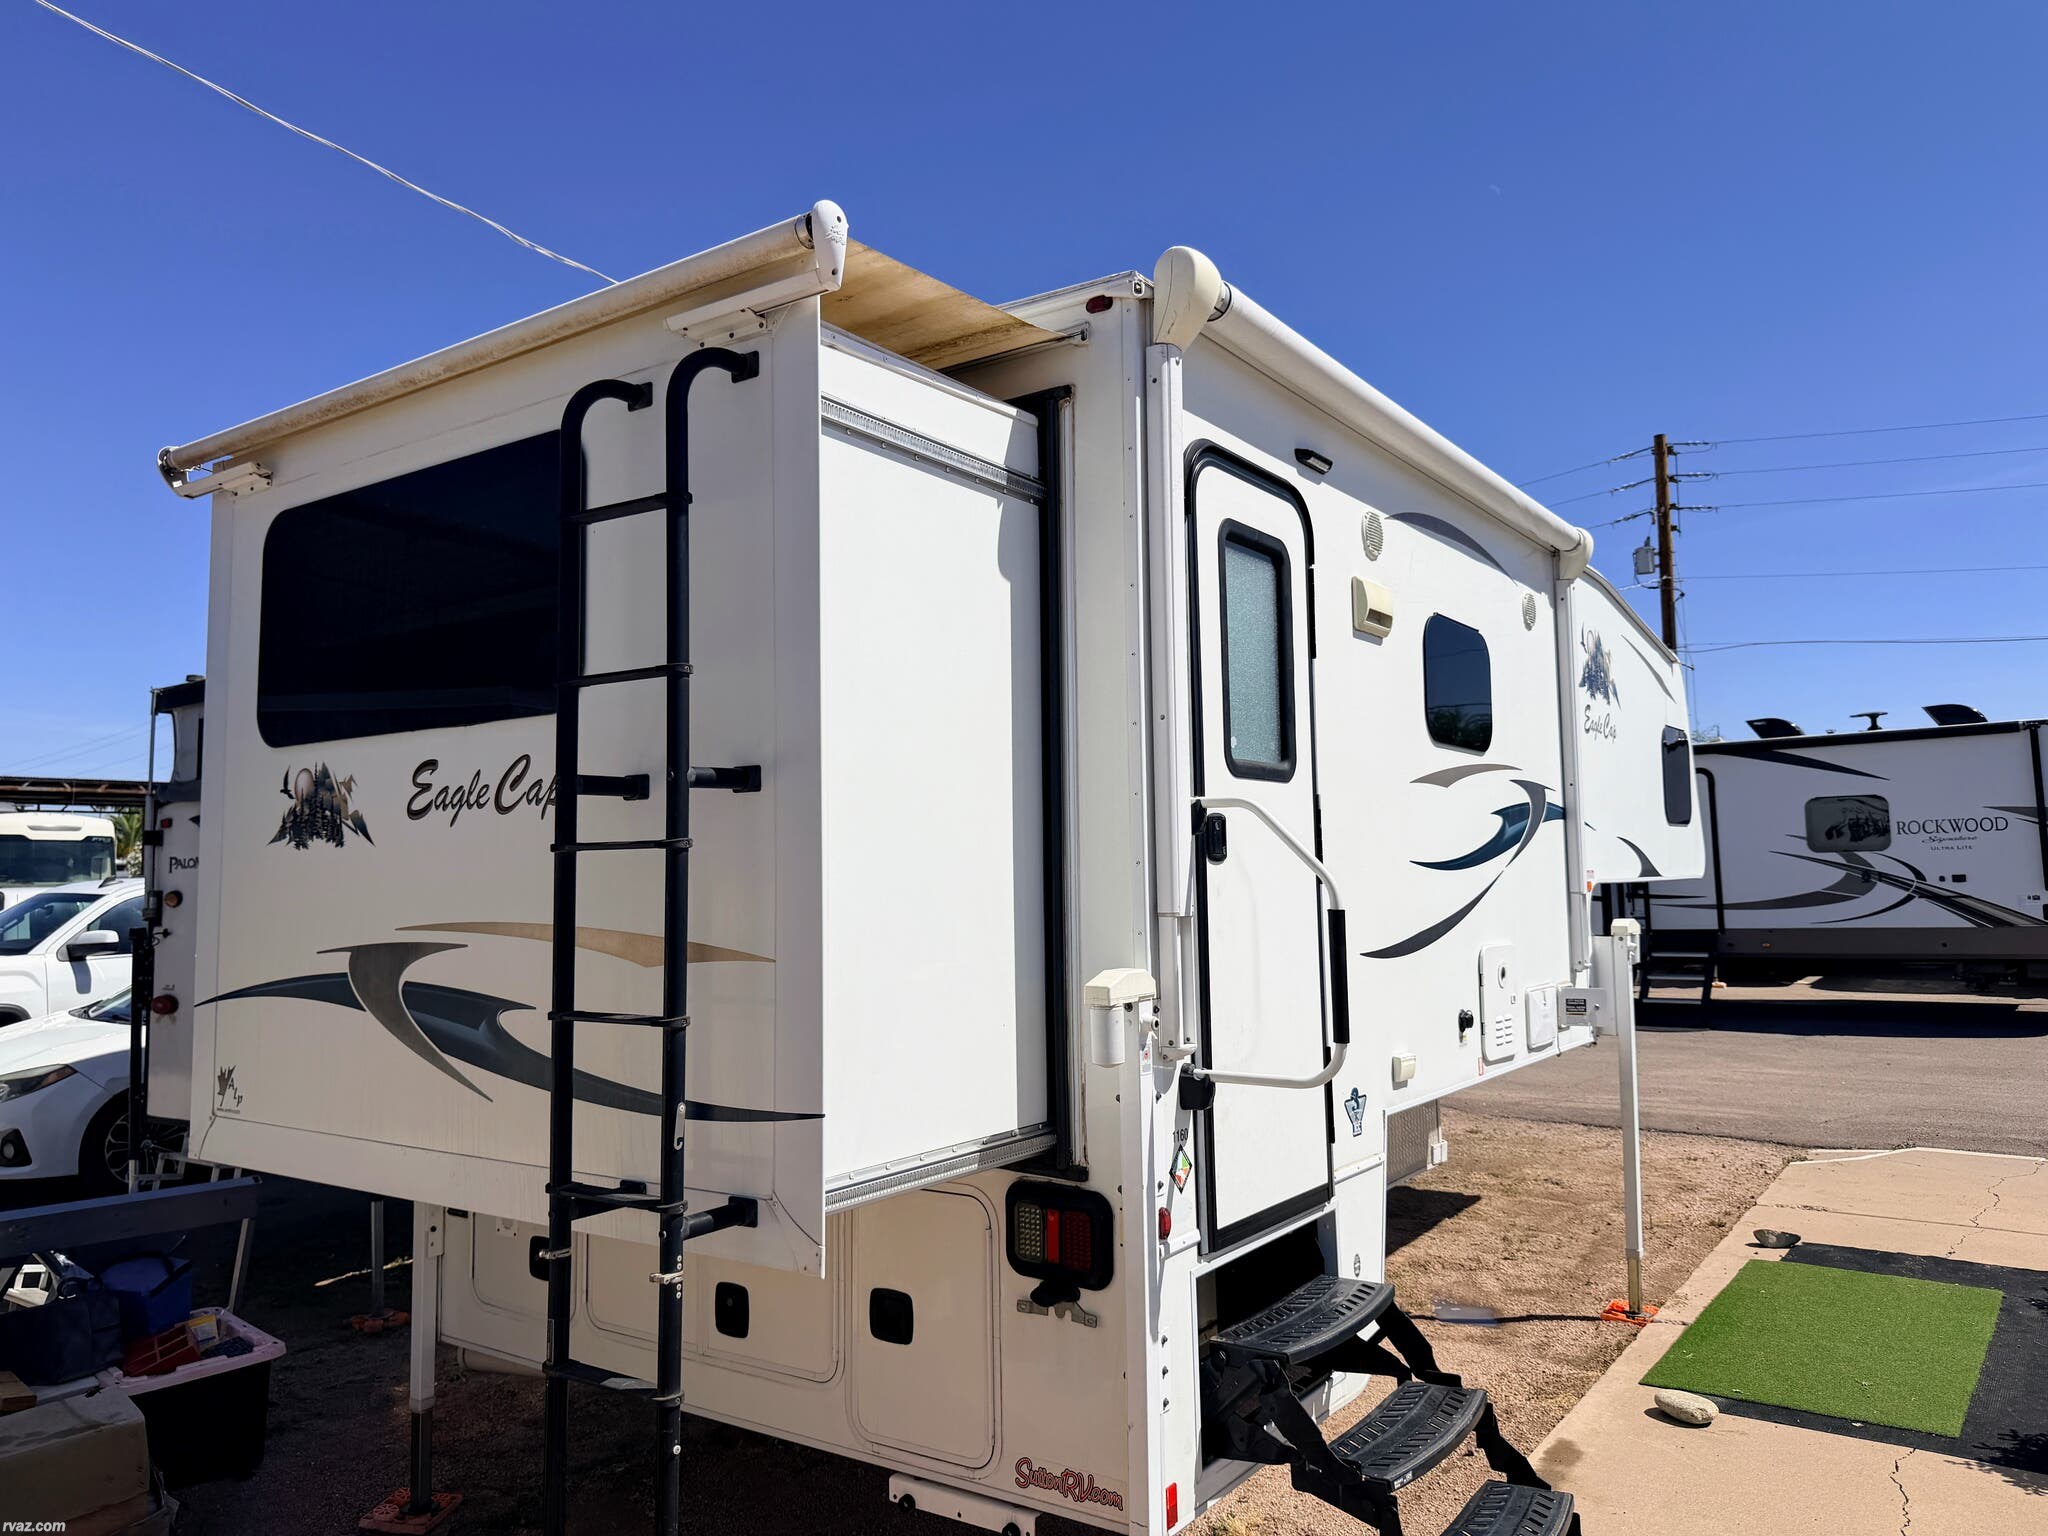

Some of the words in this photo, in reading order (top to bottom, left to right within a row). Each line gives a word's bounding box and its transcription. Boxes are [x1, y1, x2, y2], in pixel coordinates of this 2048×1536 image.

[1584, 704, 1603, 741] Eagle
[406, 758, 491, 828] Eagle
[1895, 816, 2009, 836] ROCKWOOD
[1172, 1127, 1189, 1144] 1160
[1014, 1456, 1124, 1512] SuttonRV.com
